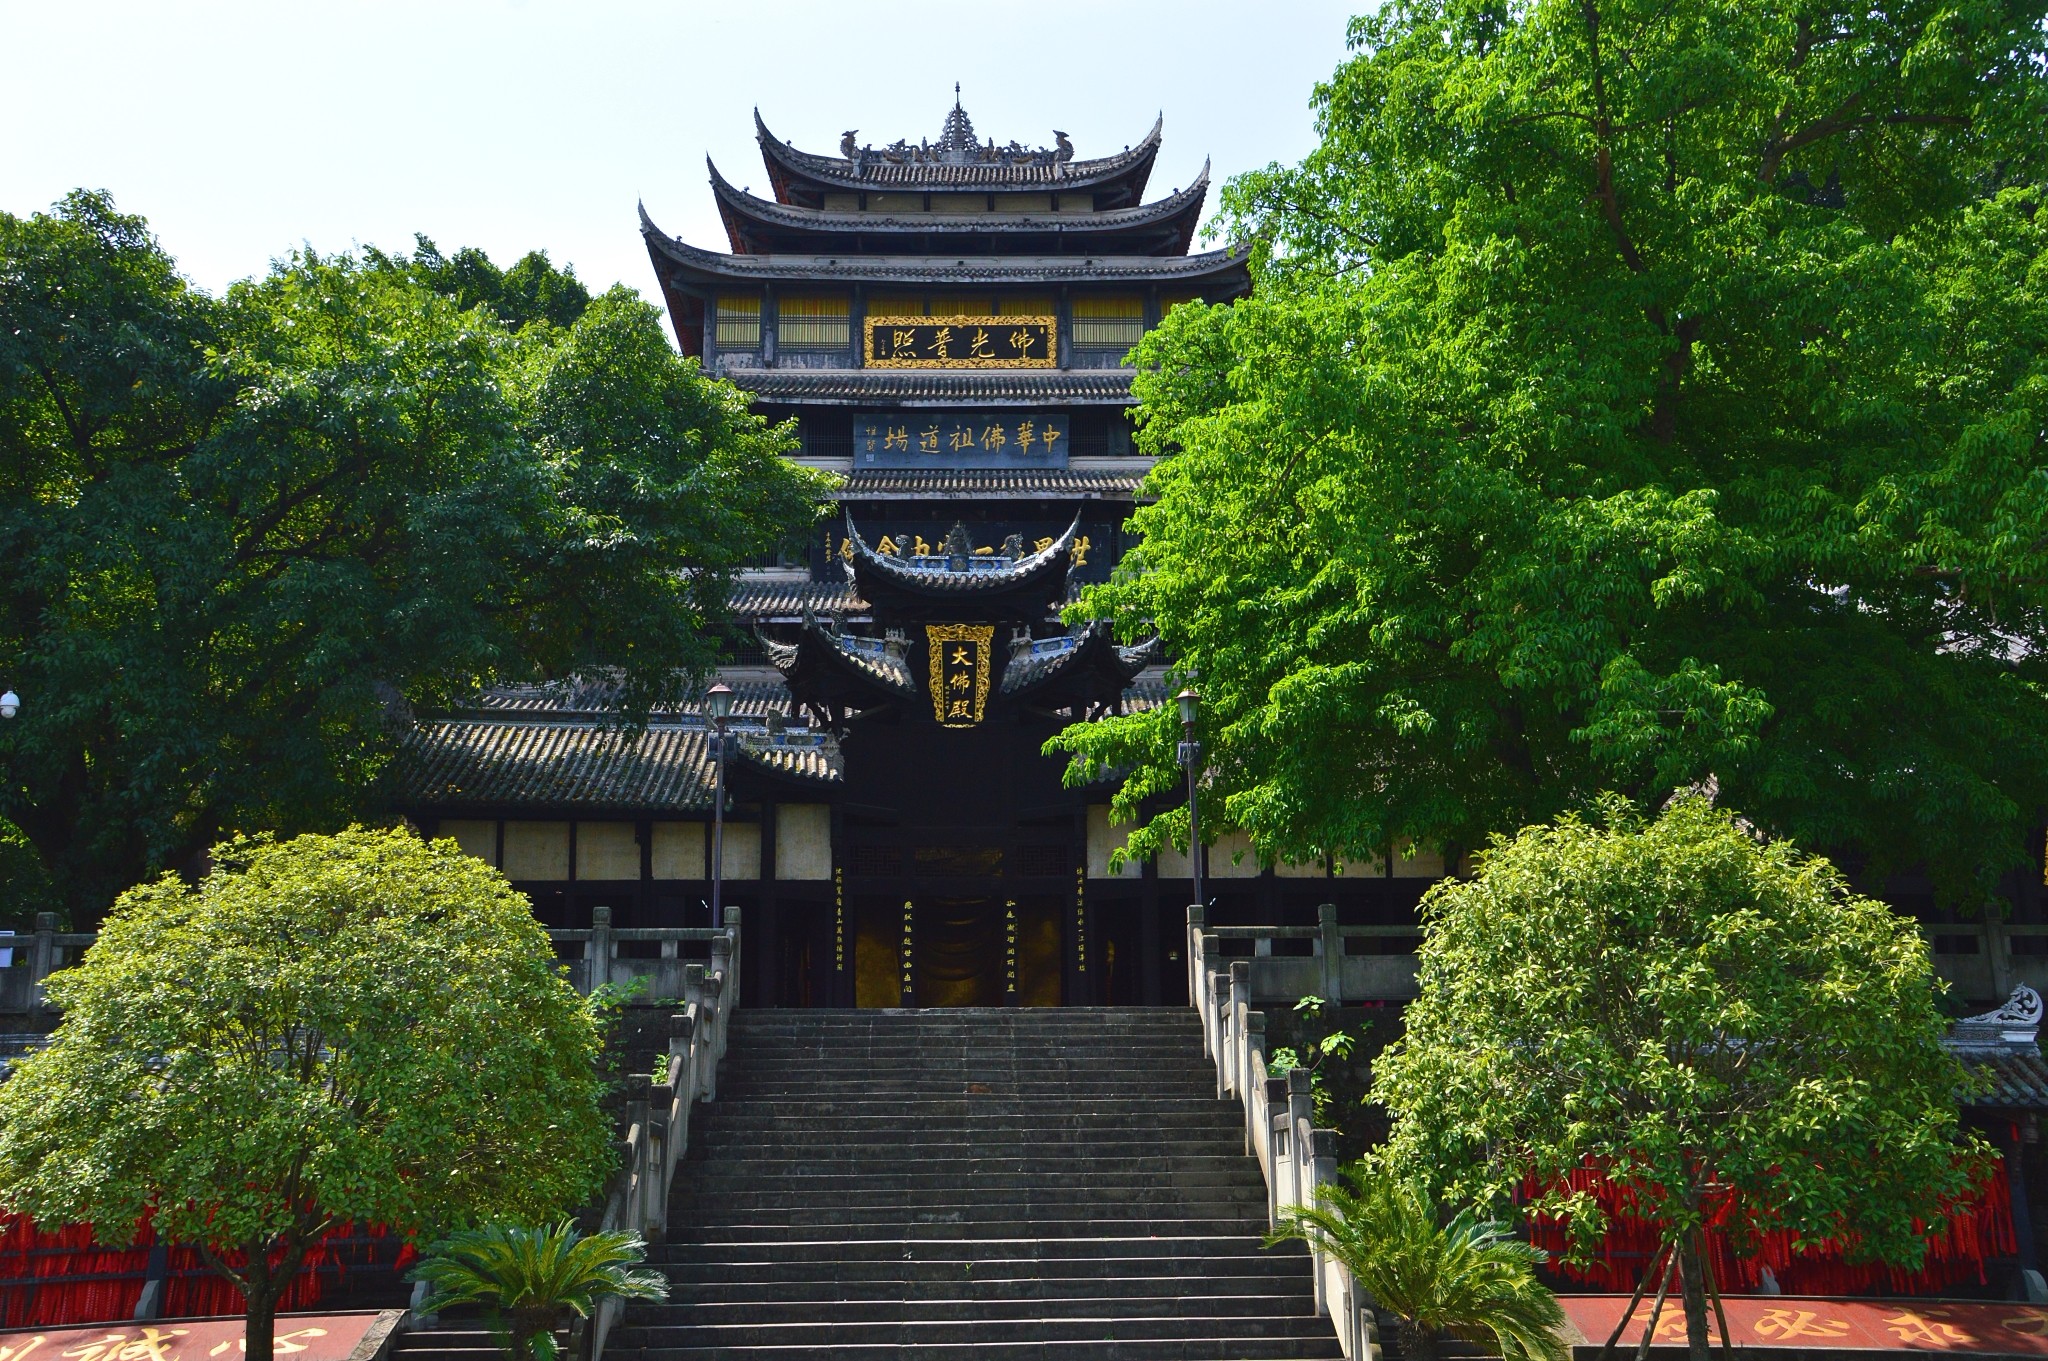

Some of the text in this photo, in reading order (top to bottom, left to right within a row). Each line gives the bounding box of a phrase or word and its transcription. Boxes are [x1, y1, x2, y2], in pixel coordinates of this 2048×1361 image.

[892, 327, 1035, 358] 佛光普照
[884, 421, 1061, 456] 中華佛祖道場
[948, 646, 973, 718] 大佛殿
